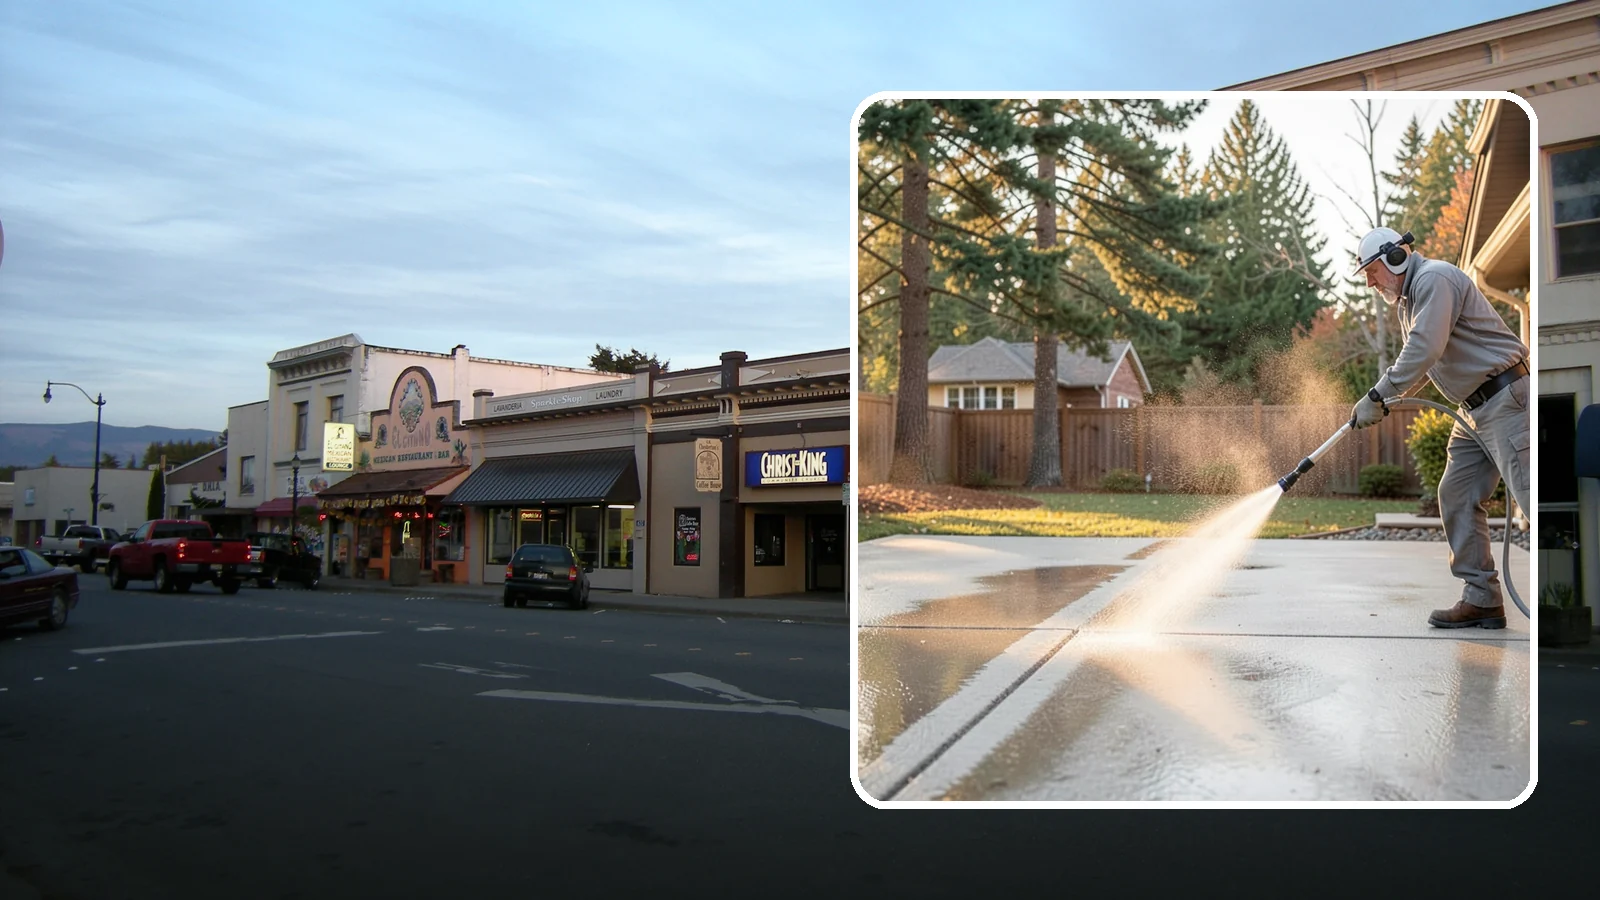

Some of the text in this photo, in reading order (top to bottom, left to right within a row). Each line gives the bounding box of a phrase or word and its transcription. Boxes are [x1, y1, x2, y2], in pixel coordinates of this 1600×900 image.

[595, 389, 623, 400] LAUNDRY
[493, 402, 522, 412] LAVANDERIA
[531, 395, 583, 409] Sparkle Shop
[392, 426, 401, 449] EL
[374, 456, 395, 464] MEXICAN
[397, 451, 433, 462] RESTAURANT
[438, 450, 450, 459] BAR
[761, 451, 827, 477] CHRIST KING
[696, 481, 721, 489] Coffee House
